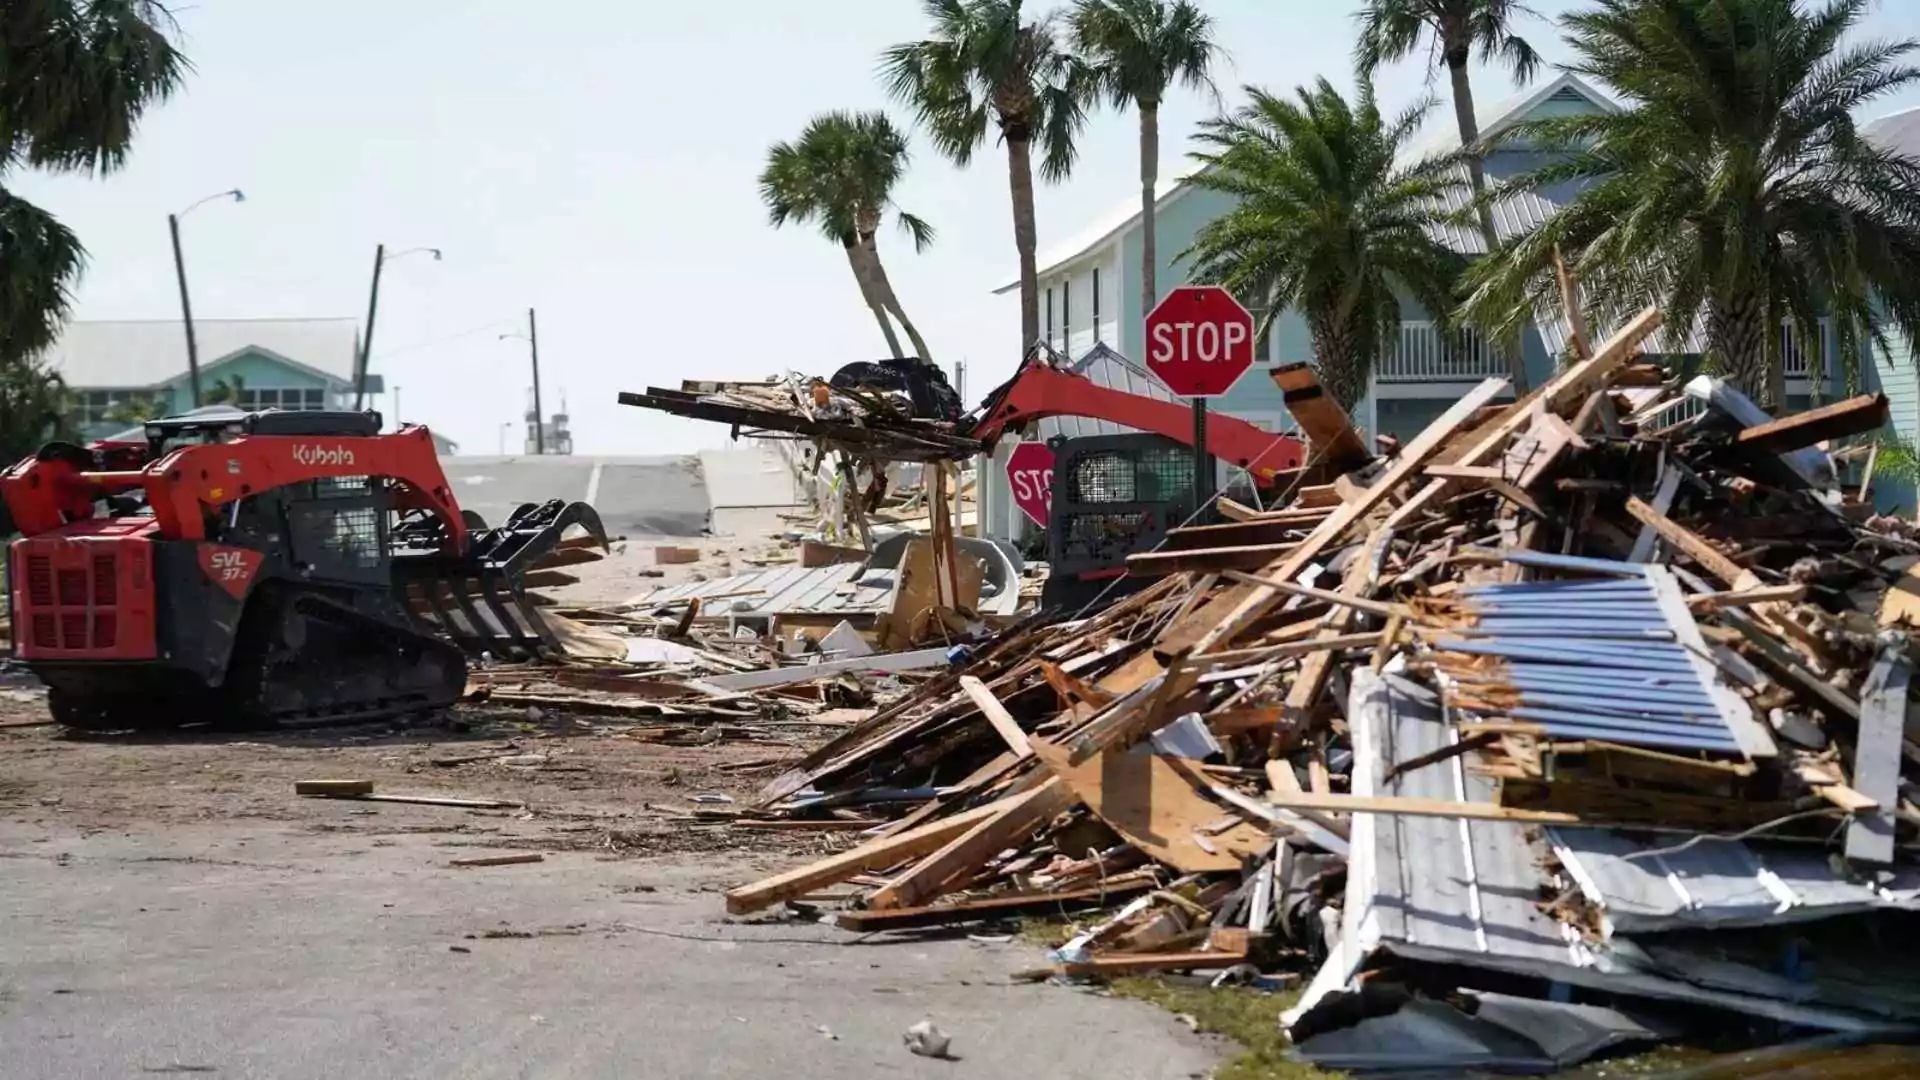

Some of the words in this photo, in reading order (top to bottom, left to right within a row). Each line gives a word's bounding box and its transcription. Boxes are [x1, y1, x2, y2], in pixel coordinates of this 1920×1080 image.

[1152, 321, 1246, 362] STOP
[293, 444, 354, 465] Kubota
[211, 551, 247, 568] SVL
